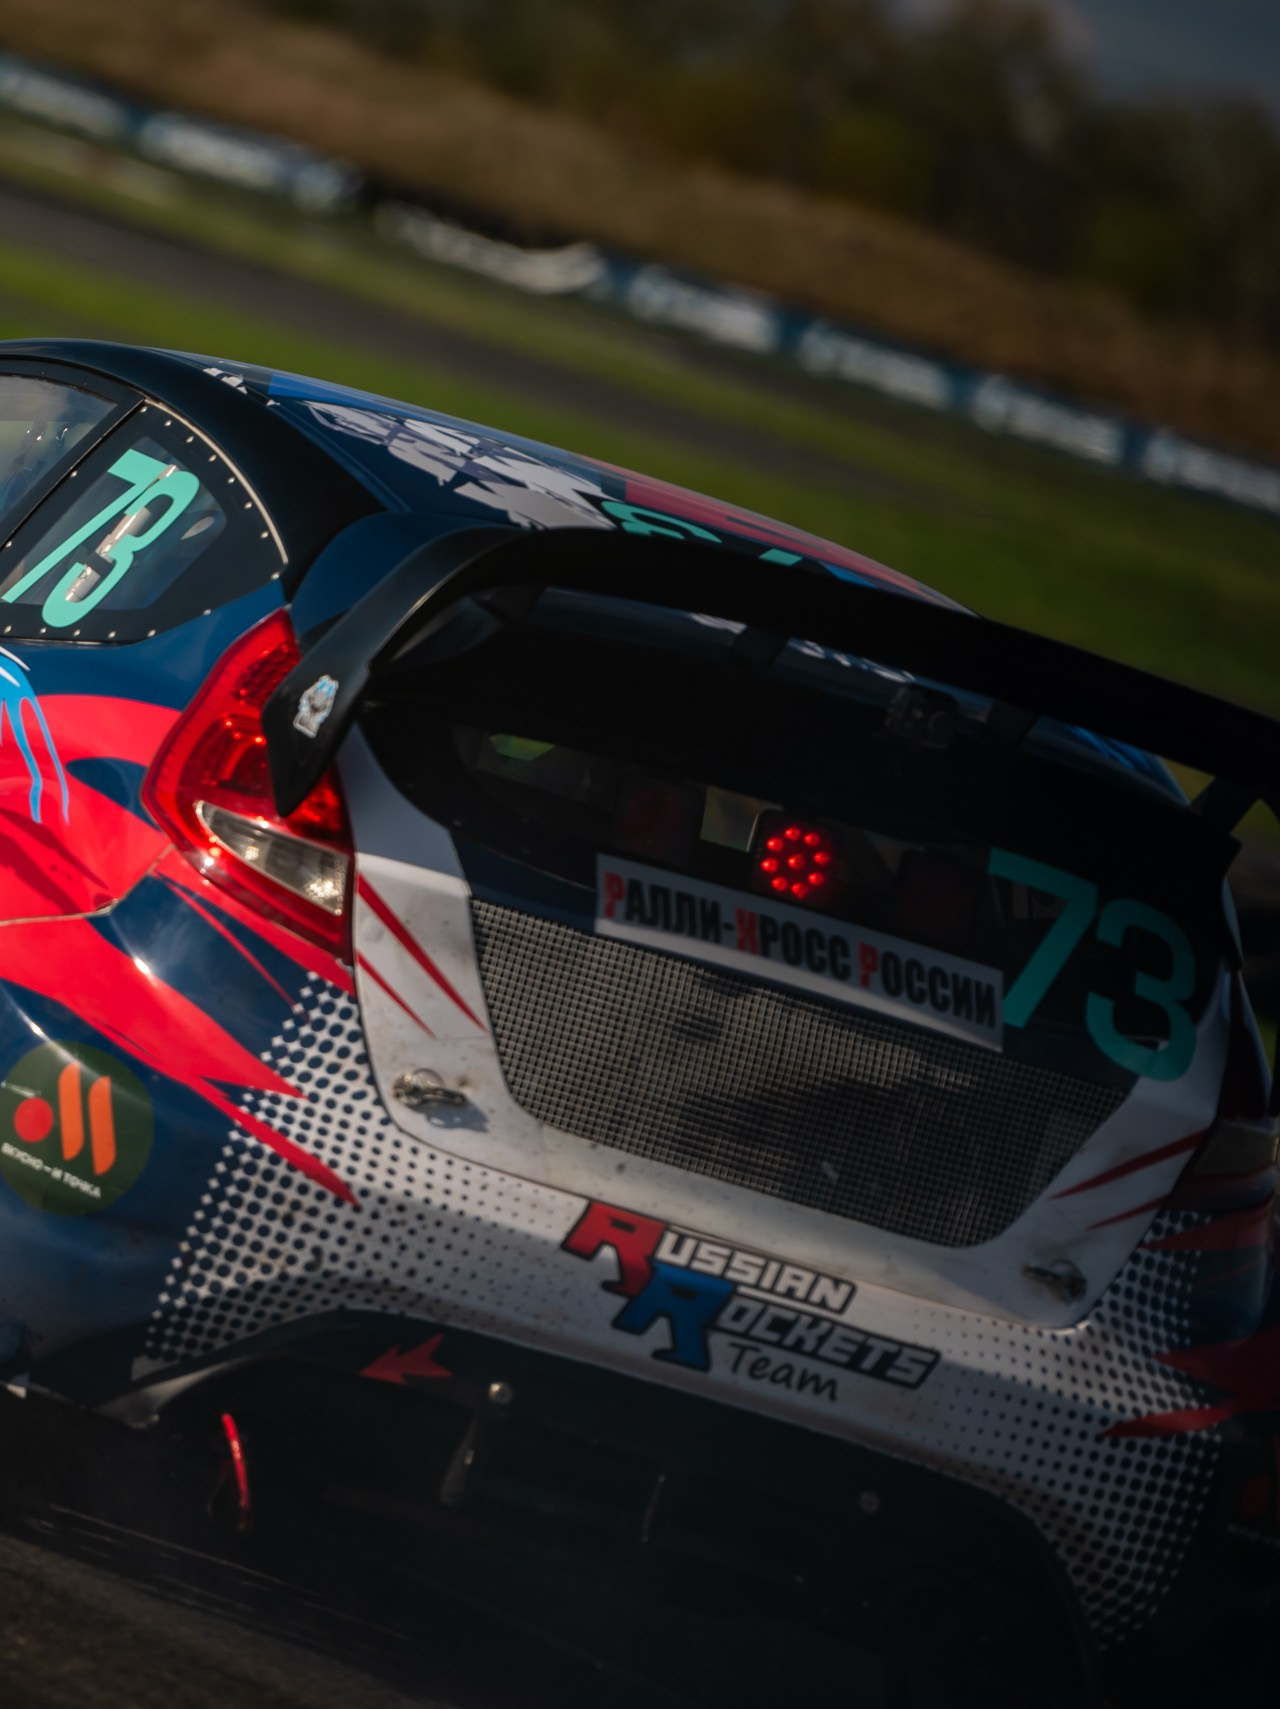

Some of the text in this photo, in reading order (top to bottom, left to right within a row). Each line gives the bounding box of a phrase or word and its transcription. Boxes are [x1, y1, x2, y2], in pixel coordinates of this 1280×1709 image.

[1, 448, 200, 628] 73
[604, 871, 996, 1030] РАЛЛИ-КРОСС РОССИИ
[987, 847, 1197, 1083] 73
[730, 1341, 837, 1401] Team
